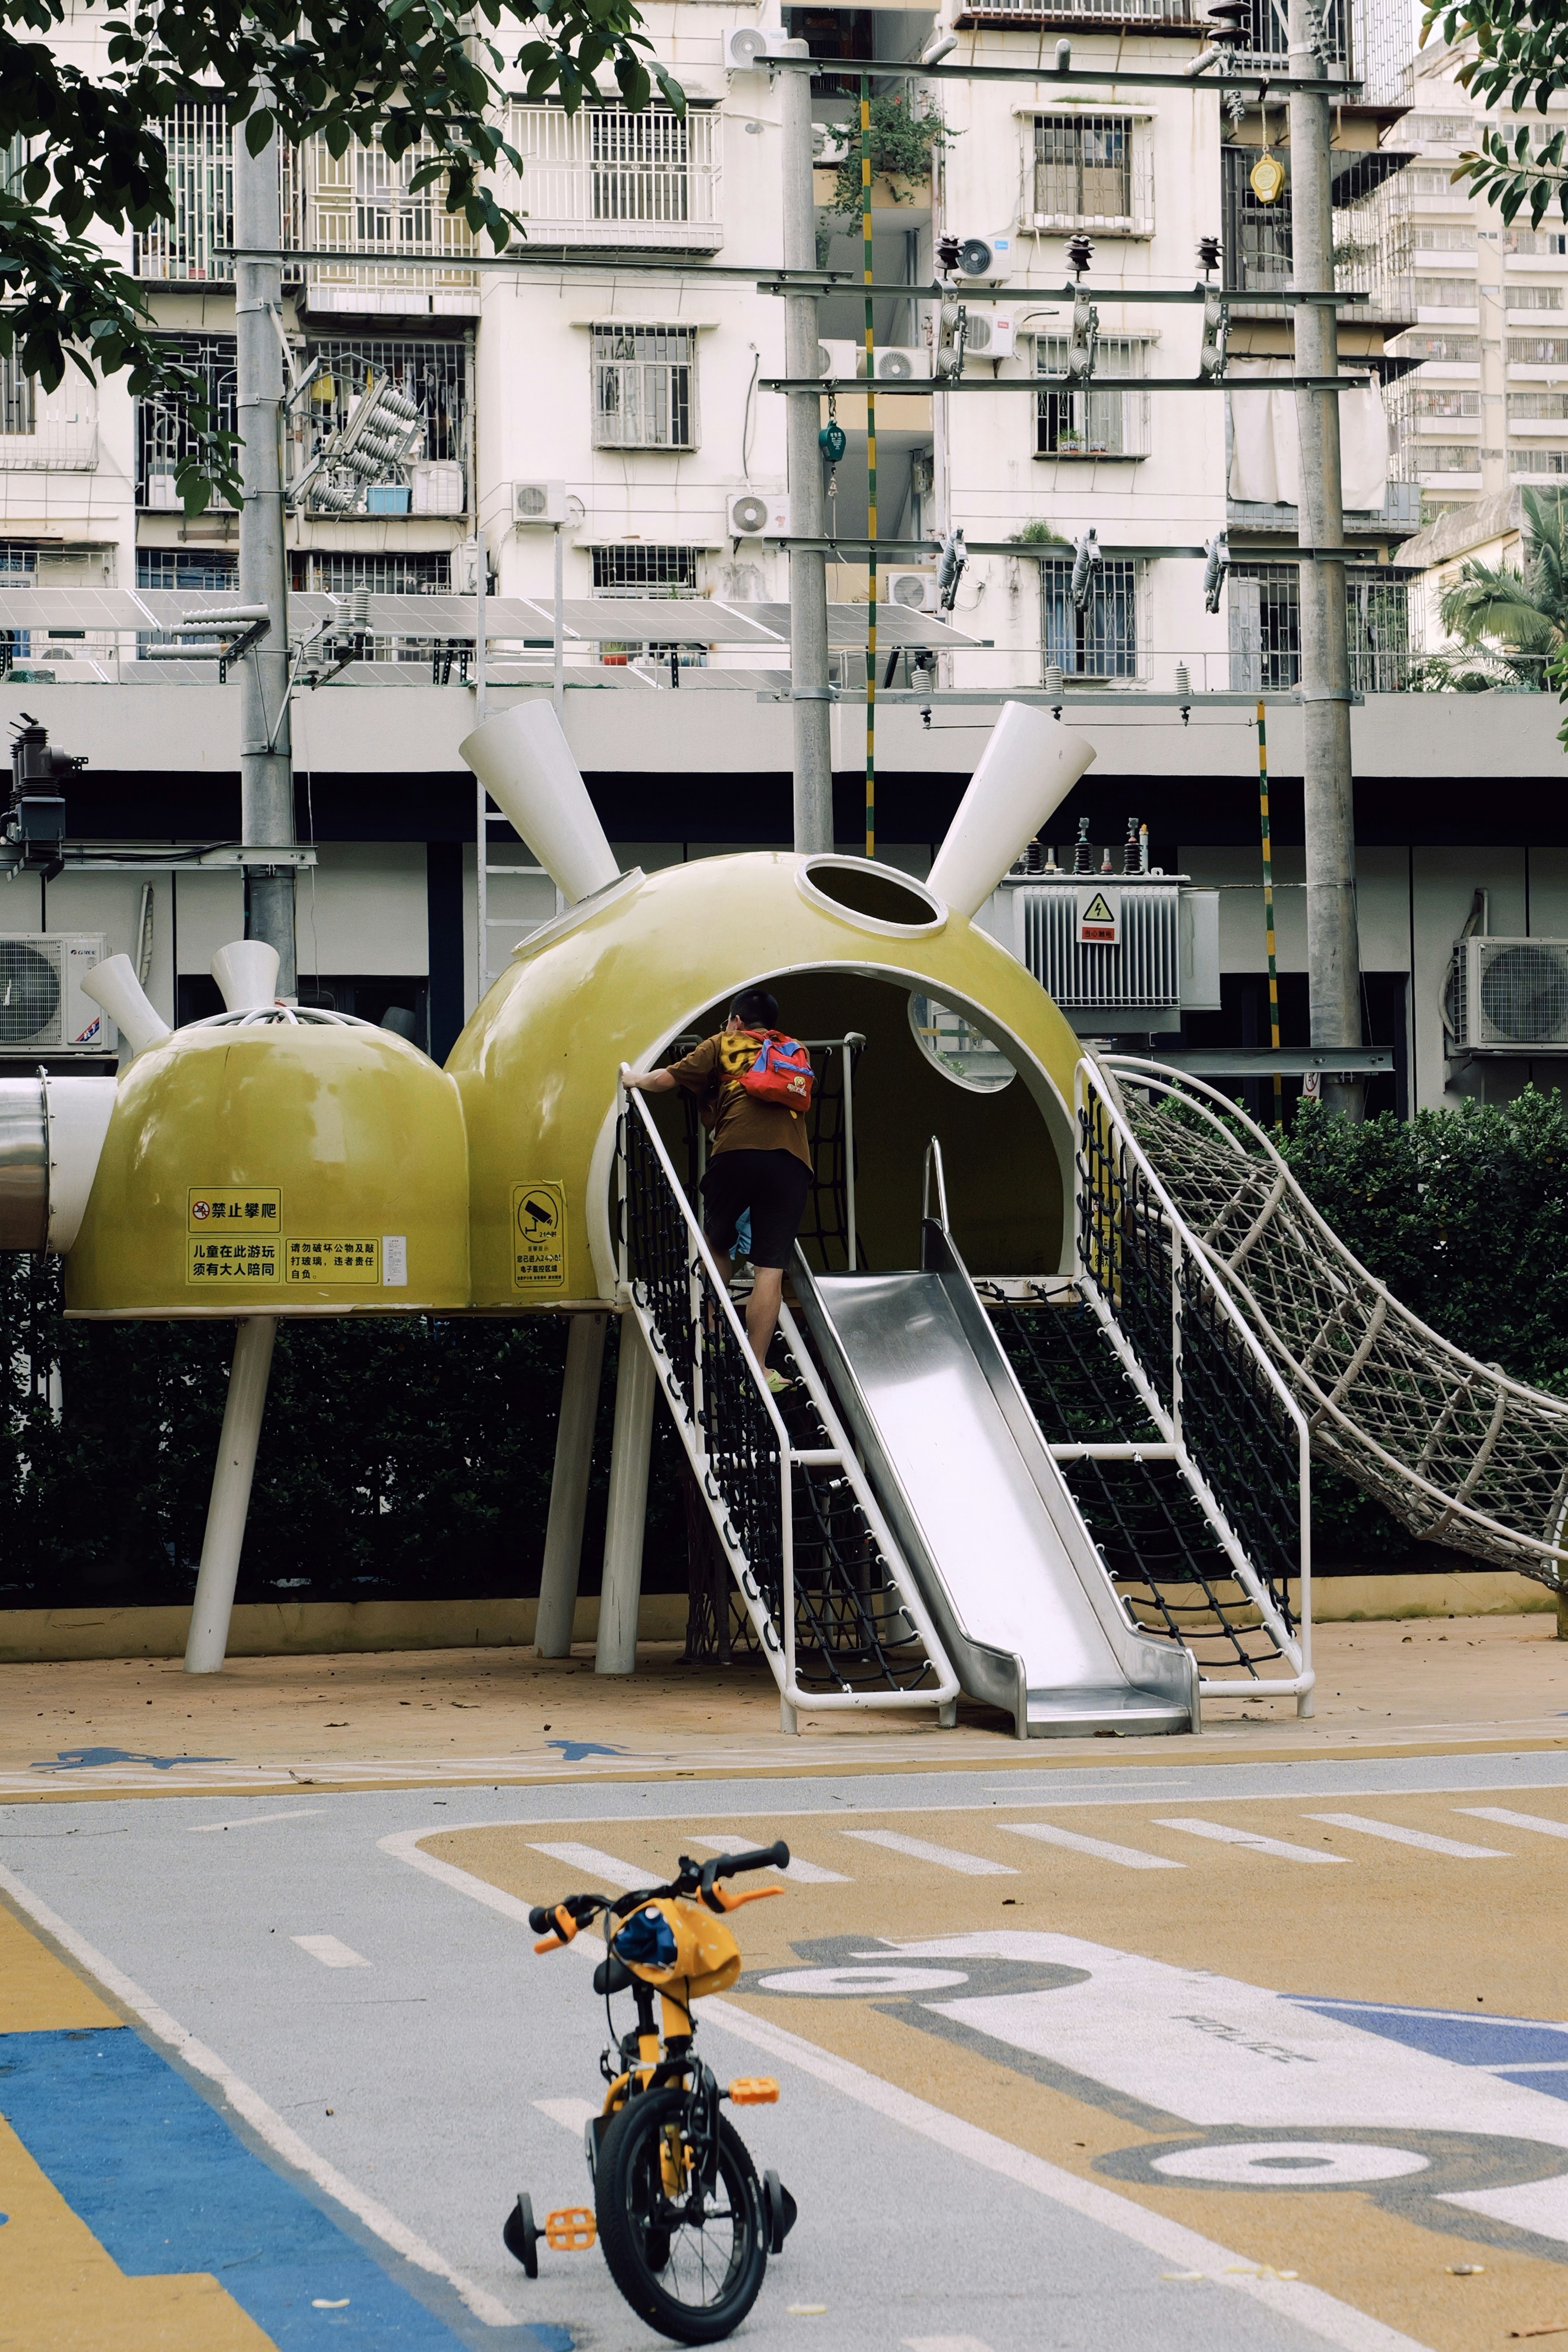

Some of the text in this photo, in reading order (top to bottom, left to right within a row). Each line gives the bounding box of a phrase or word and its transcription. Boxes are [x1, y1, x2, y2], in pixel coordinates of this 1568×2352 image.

[1085, 930, 1112, 938] 当心触电
[211, 1202, 276, 1218] 禁止攀爬
[193, 1245, 275, 1258] 儿童在此游玩
[291, 1243, 374, 1254] 请勿破坏公物及敲
[291, 1256, 374, 1266] 打玻璃，违者责任
[193, 1262, 275, 1276] 须有大人陪同
[291, 1270, 317, 1280] 自负。
[1168, 2015, 1318, 2064] POLICE
